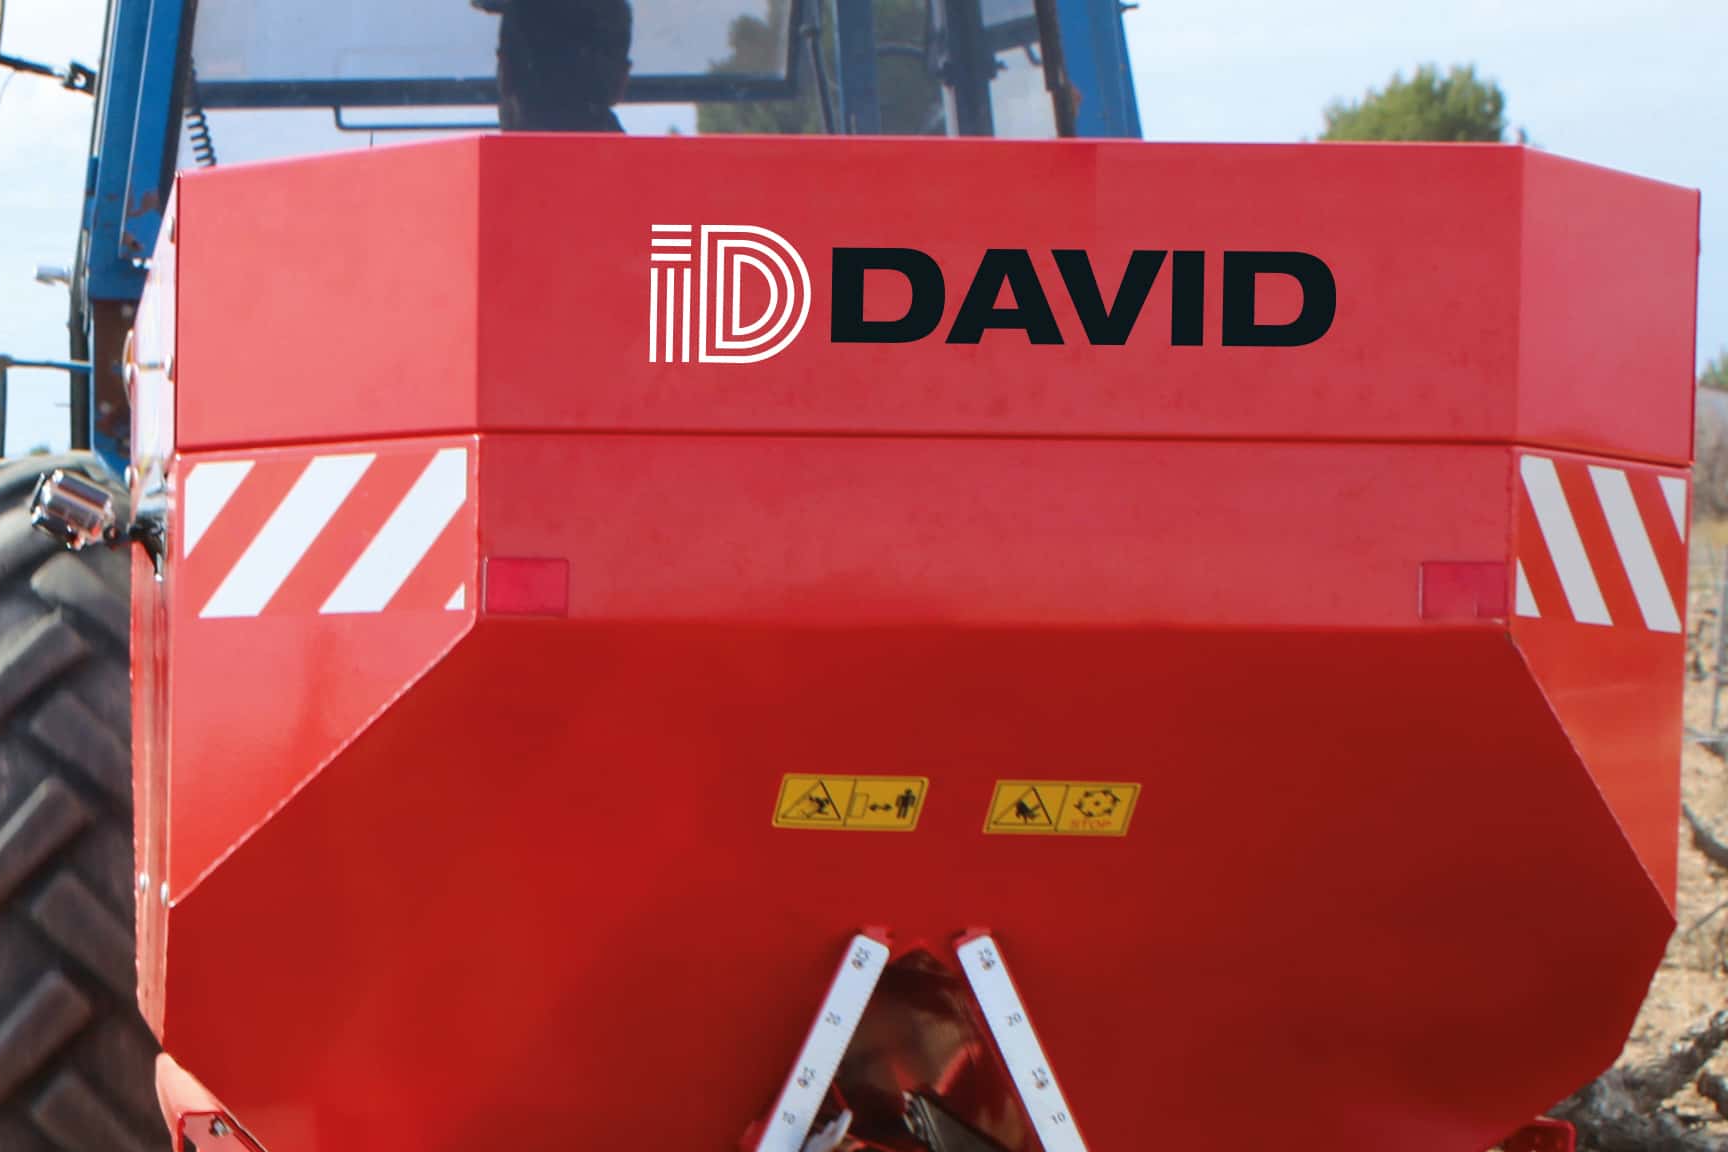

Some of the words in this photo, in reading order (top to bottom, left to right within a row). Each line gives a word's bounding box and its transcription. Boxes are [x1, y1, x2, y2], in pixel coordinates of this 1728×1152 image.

[830, 247, 1337, 348] DAVID
[1007, 1012, 1023, 1027] 20
[1051, 1111, 1066, 1125] 10
